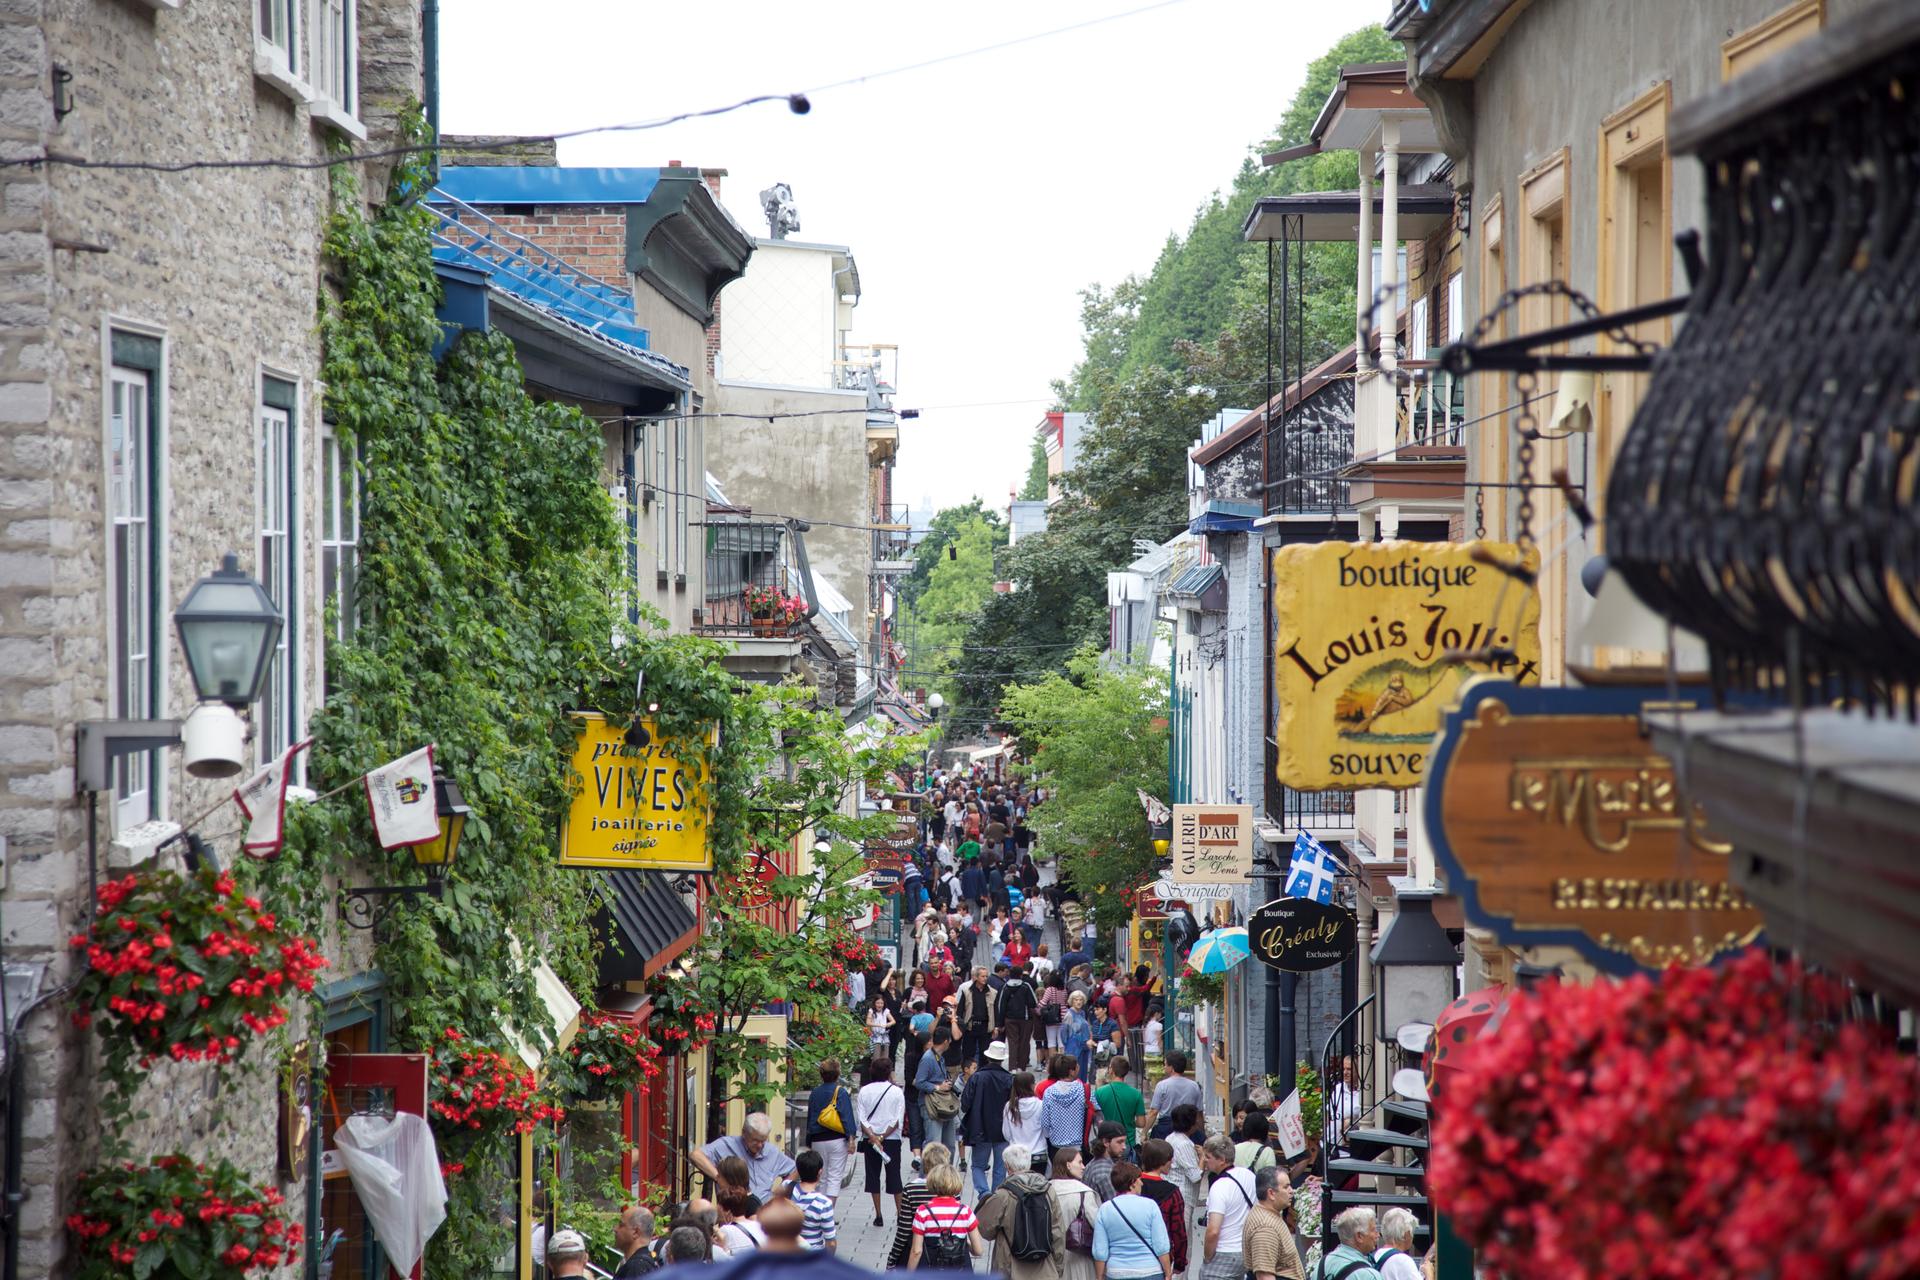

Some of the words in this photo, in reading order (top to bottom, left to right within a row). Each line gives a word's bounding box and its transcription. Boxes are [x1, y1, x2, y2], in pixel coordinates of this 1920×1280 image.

[1339, 549, 1477, 597] boutique
[1280, 615, 1408, 692] Louis
[1329, 752, 1424, 776] souve
[594, 765, 685, 812] VIVES
[592, 816, 683, 831] joaillerie
[1200, 826, 1239, 839] D'ART
[1182, 813, 1195, 875] GALERIE
[1210, 861, 1238, 875] Denis
[1158, 881, 1231, 903] Scrupules
[1552, 877, 1757, 910] RESTAURA
[1264, 910, 1295, 918] Boutique
[1260, 915, 1344, 959] Créaly
[1306, 950, 1341, 958] Exclusivité
